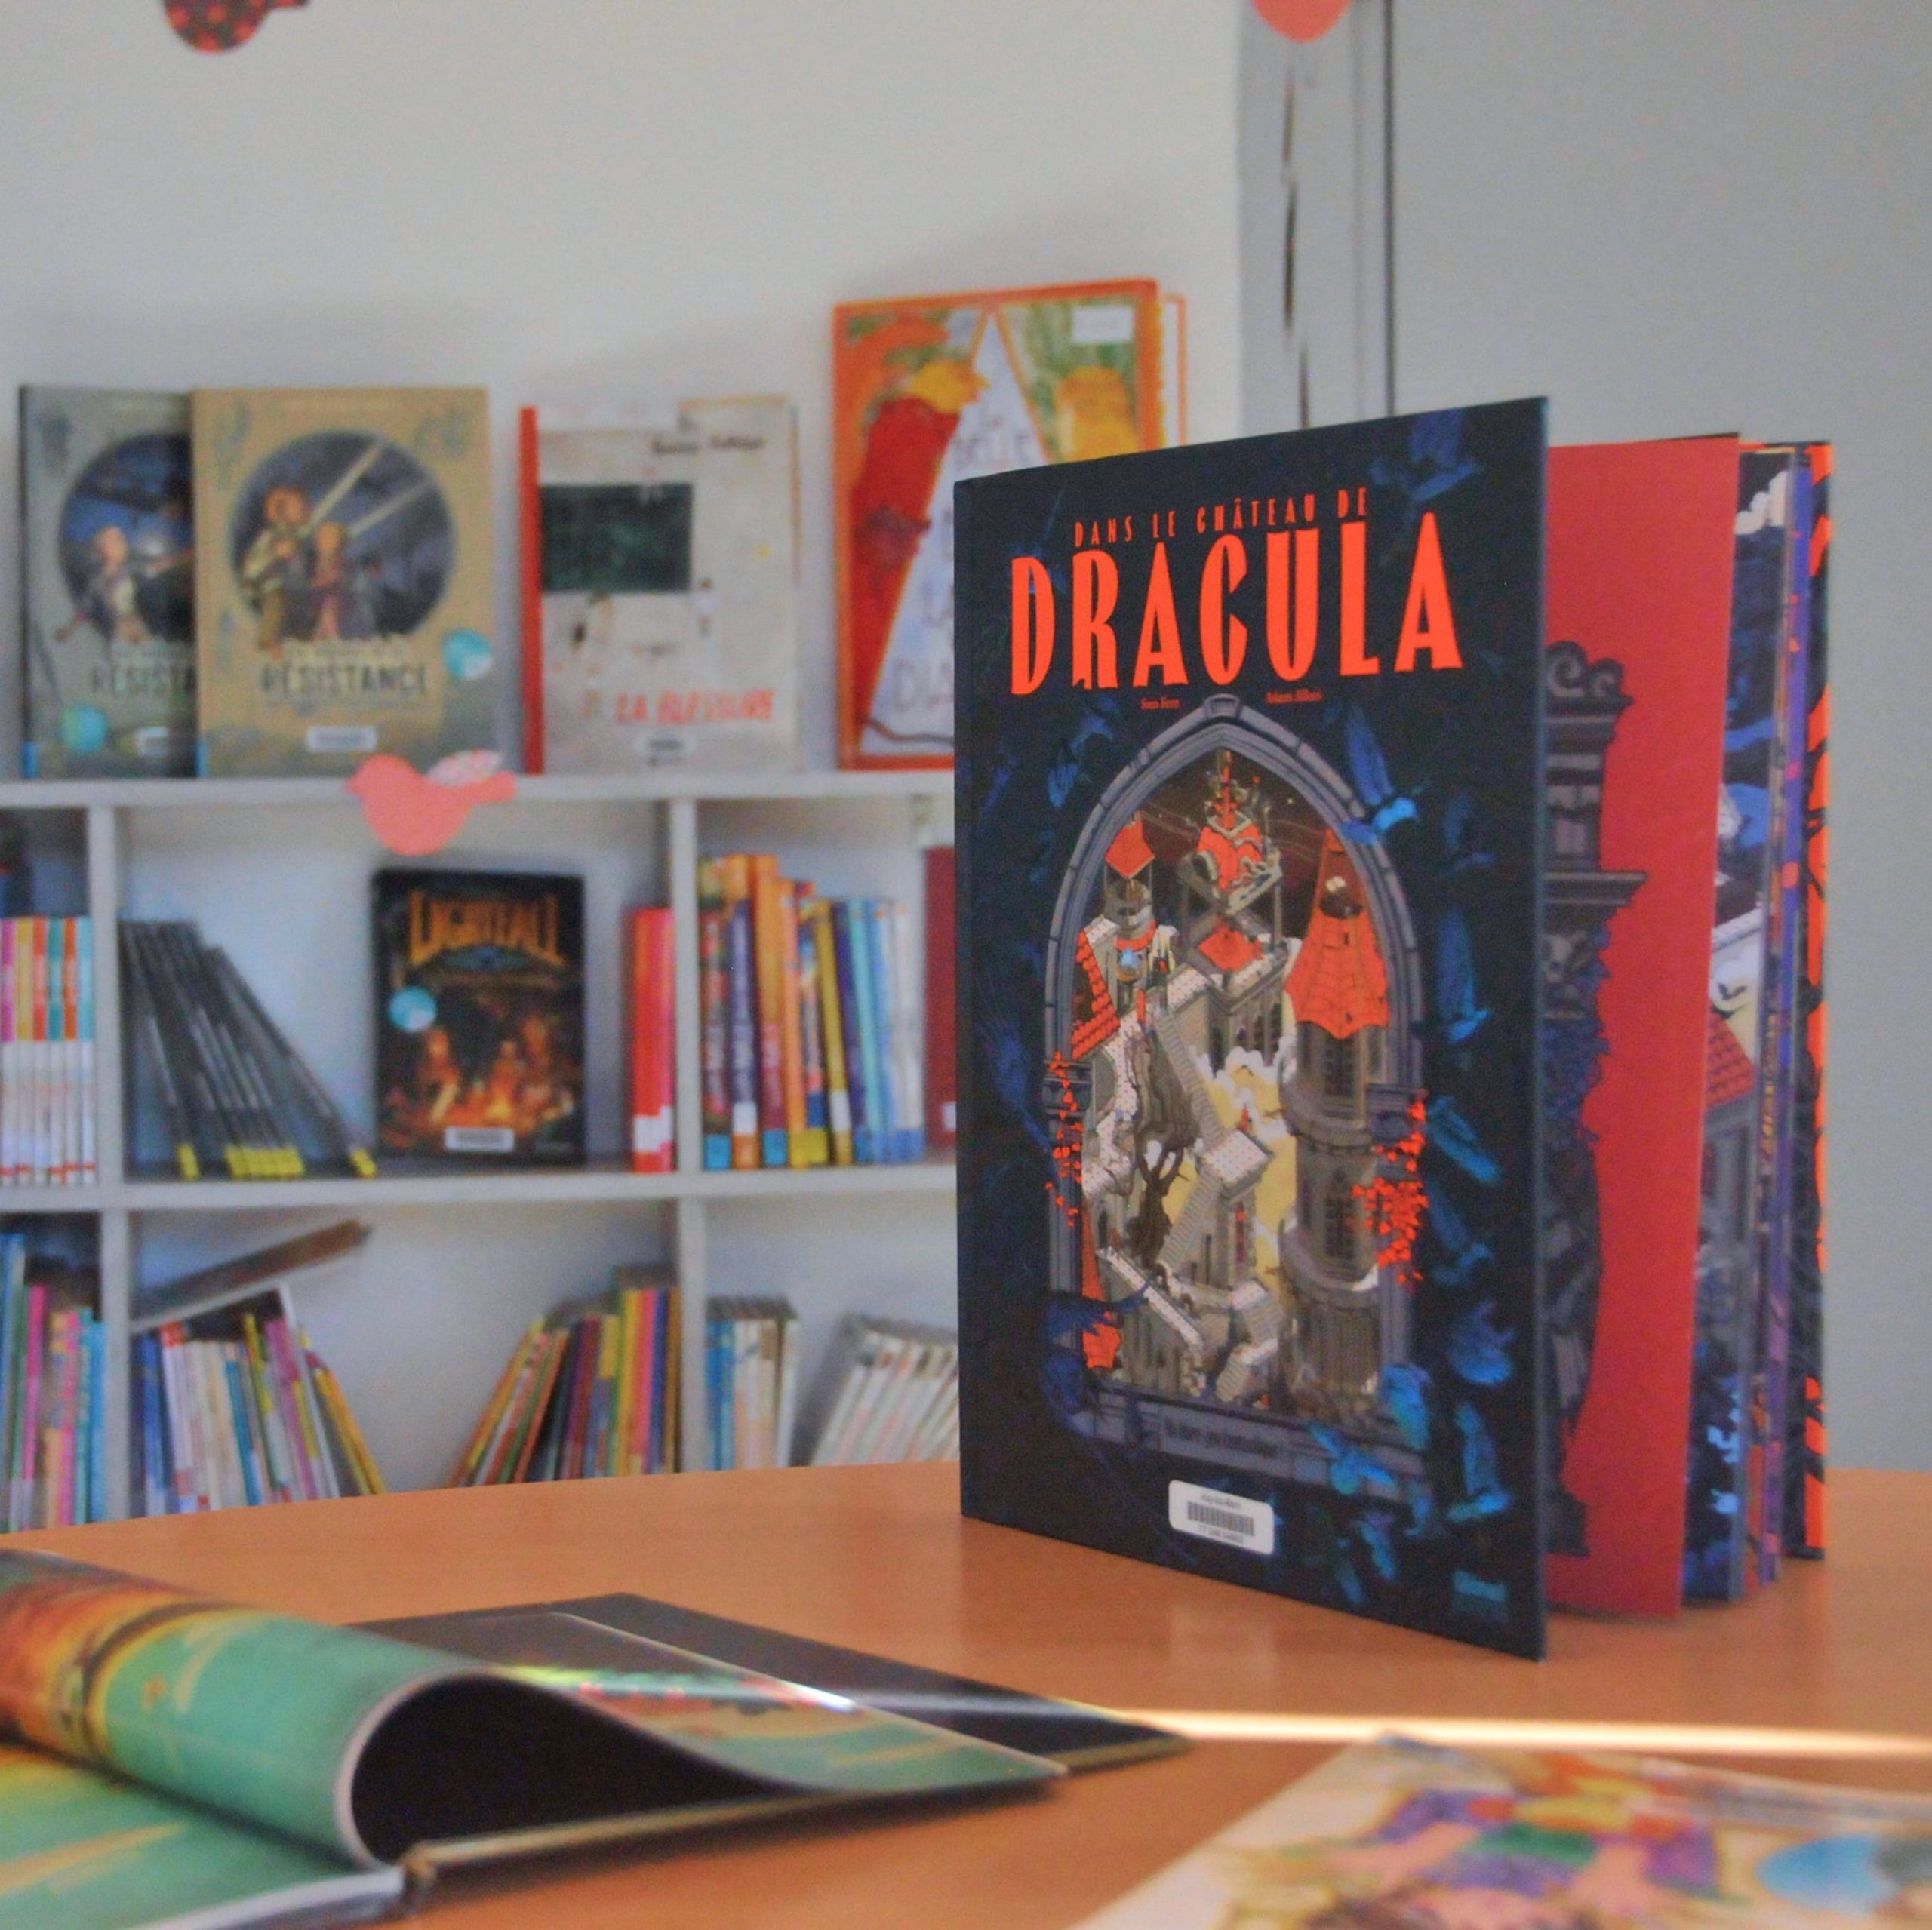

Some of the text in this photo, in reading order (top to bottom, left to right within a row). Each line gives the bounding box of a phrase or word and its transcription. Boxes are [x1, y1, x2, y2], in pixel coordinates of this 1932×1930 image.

[1073, 487, 1367, 549] DANS LE CHÂTEAU DE
[1010, 511, 1464, 696] DRACULA
